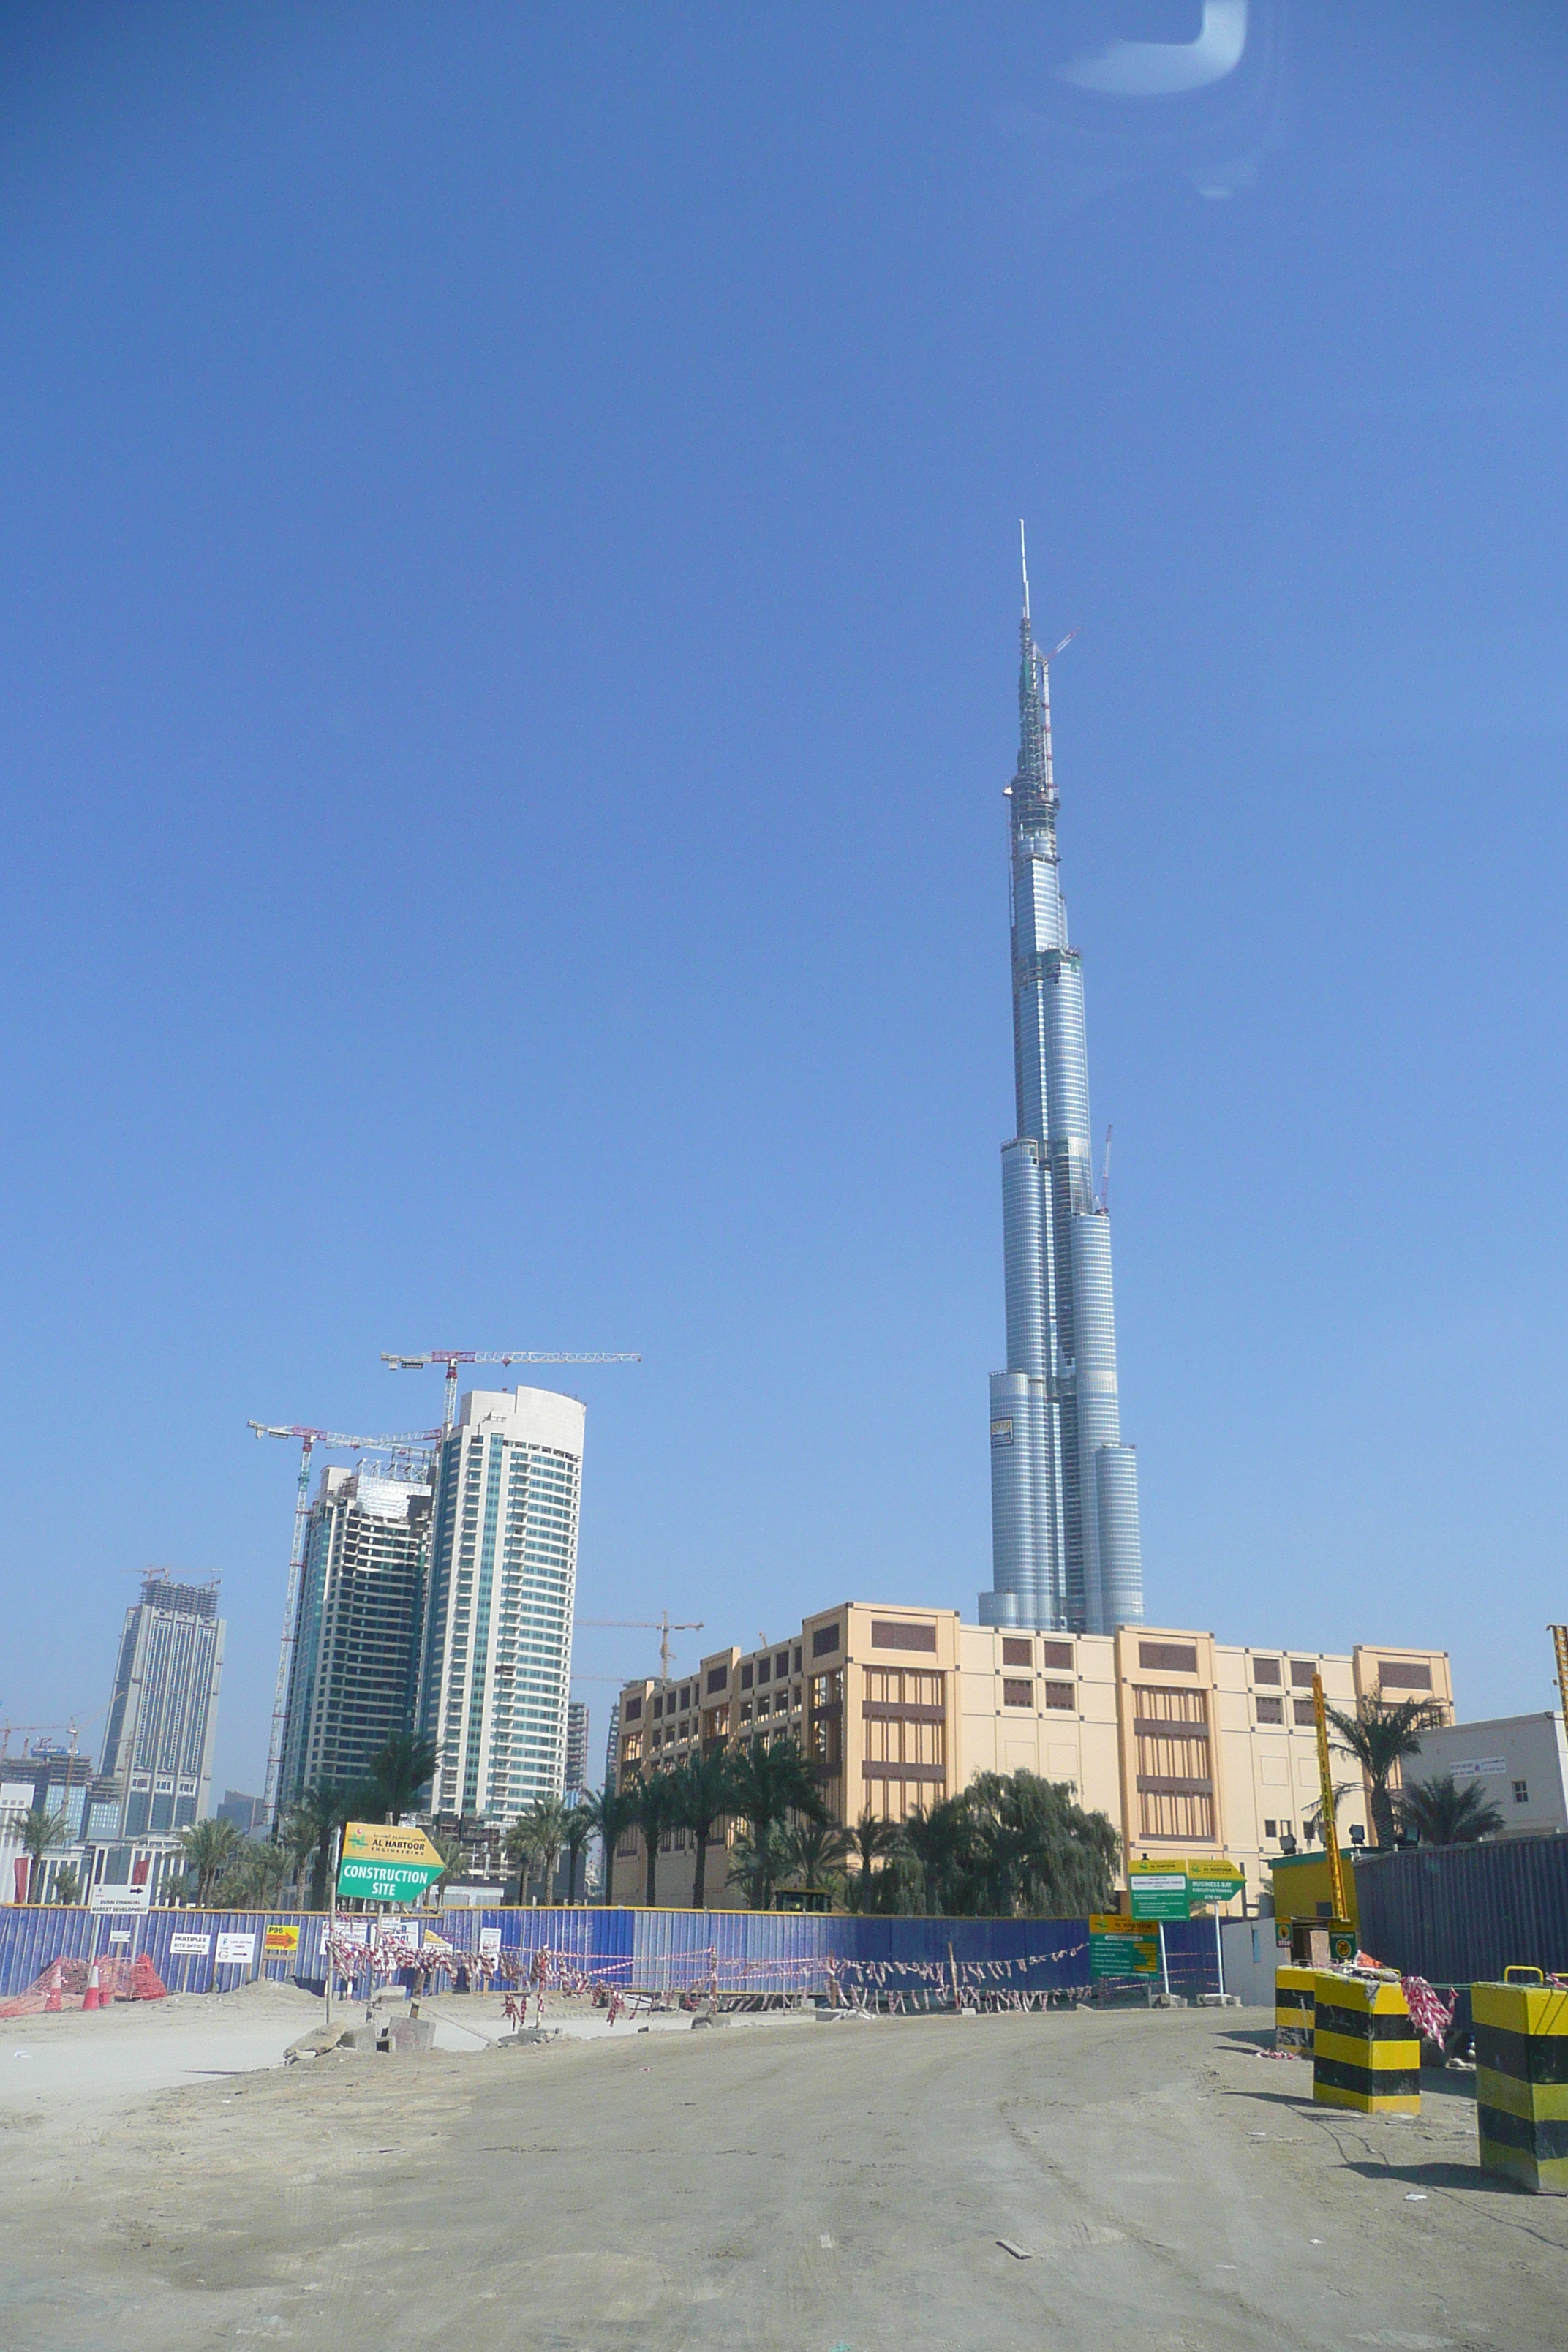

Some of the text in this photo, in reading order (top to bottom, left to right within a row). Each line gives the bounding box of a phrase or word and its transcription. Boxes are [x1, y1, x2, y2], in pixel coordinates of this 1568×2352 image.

[371, 1847, 424, 1856] ENGINEERING
[372, 1839, 426, 1851] AL HABTOOR
[344, 1865, 429, 1885] CONSTRUCTION
[372, 1882, 396, 1896] SITE
